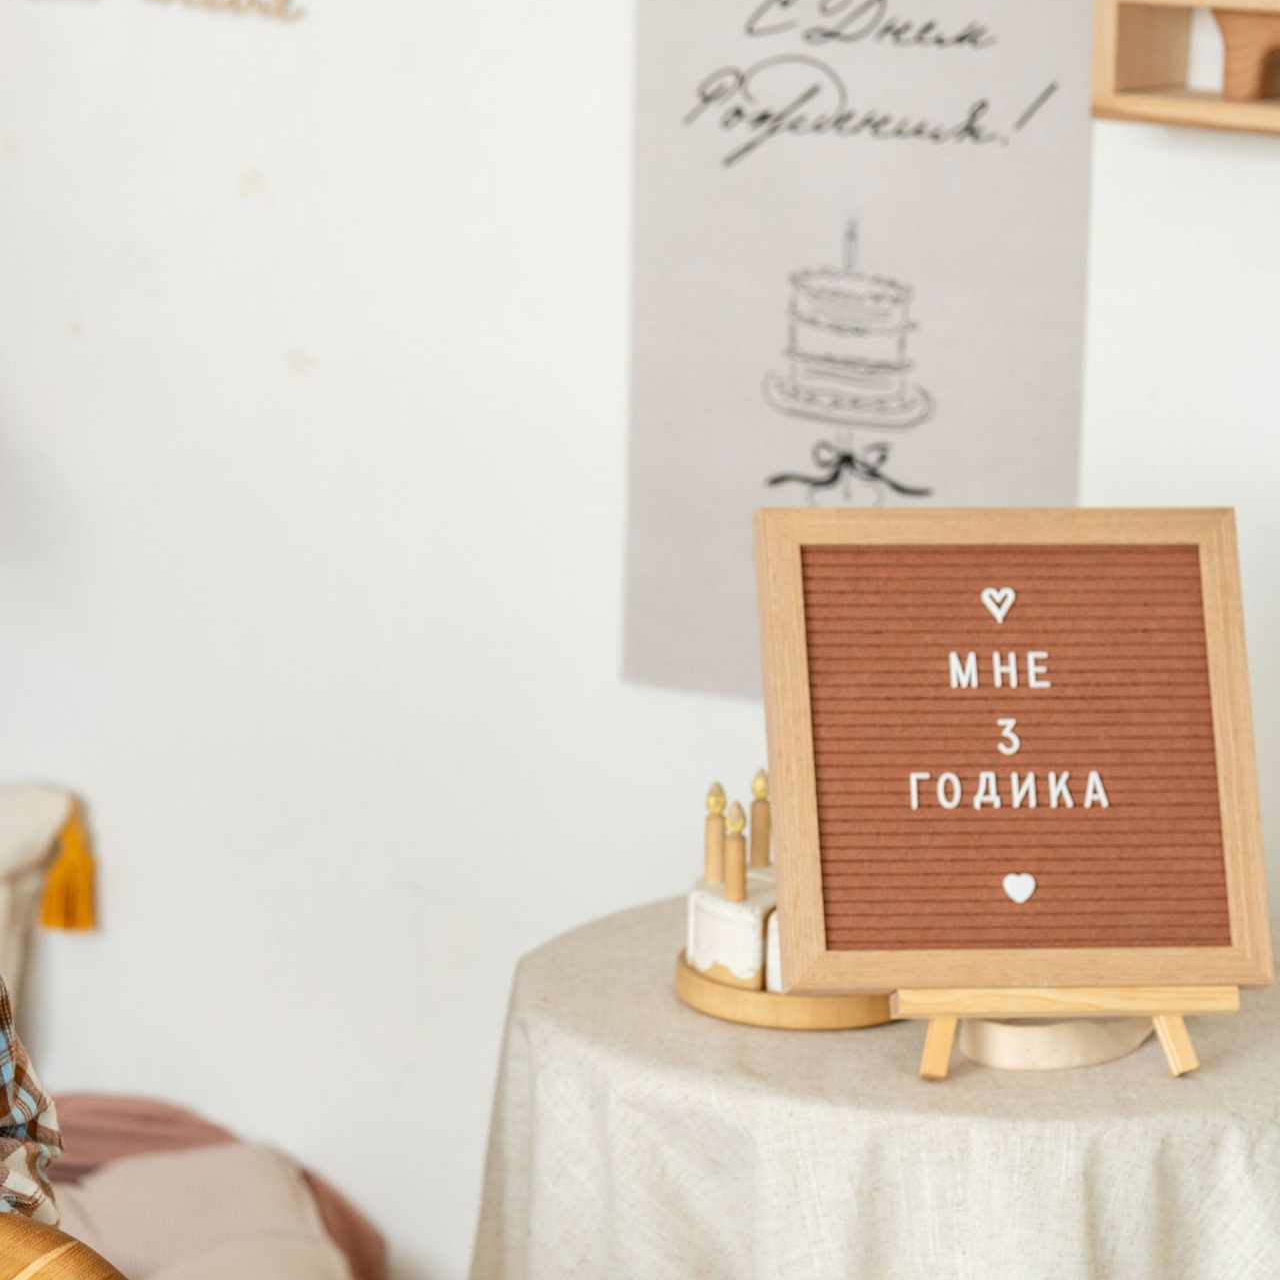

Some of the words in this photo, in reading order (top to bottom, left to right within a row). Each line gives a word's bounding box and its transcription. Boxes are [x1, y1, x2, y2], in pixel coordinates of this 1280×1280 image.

[948, 651, 1051, 689] МНЕ
[996, 718, 1020, 755] 3
[908, 771, 1109, 810] ГОДИКА
